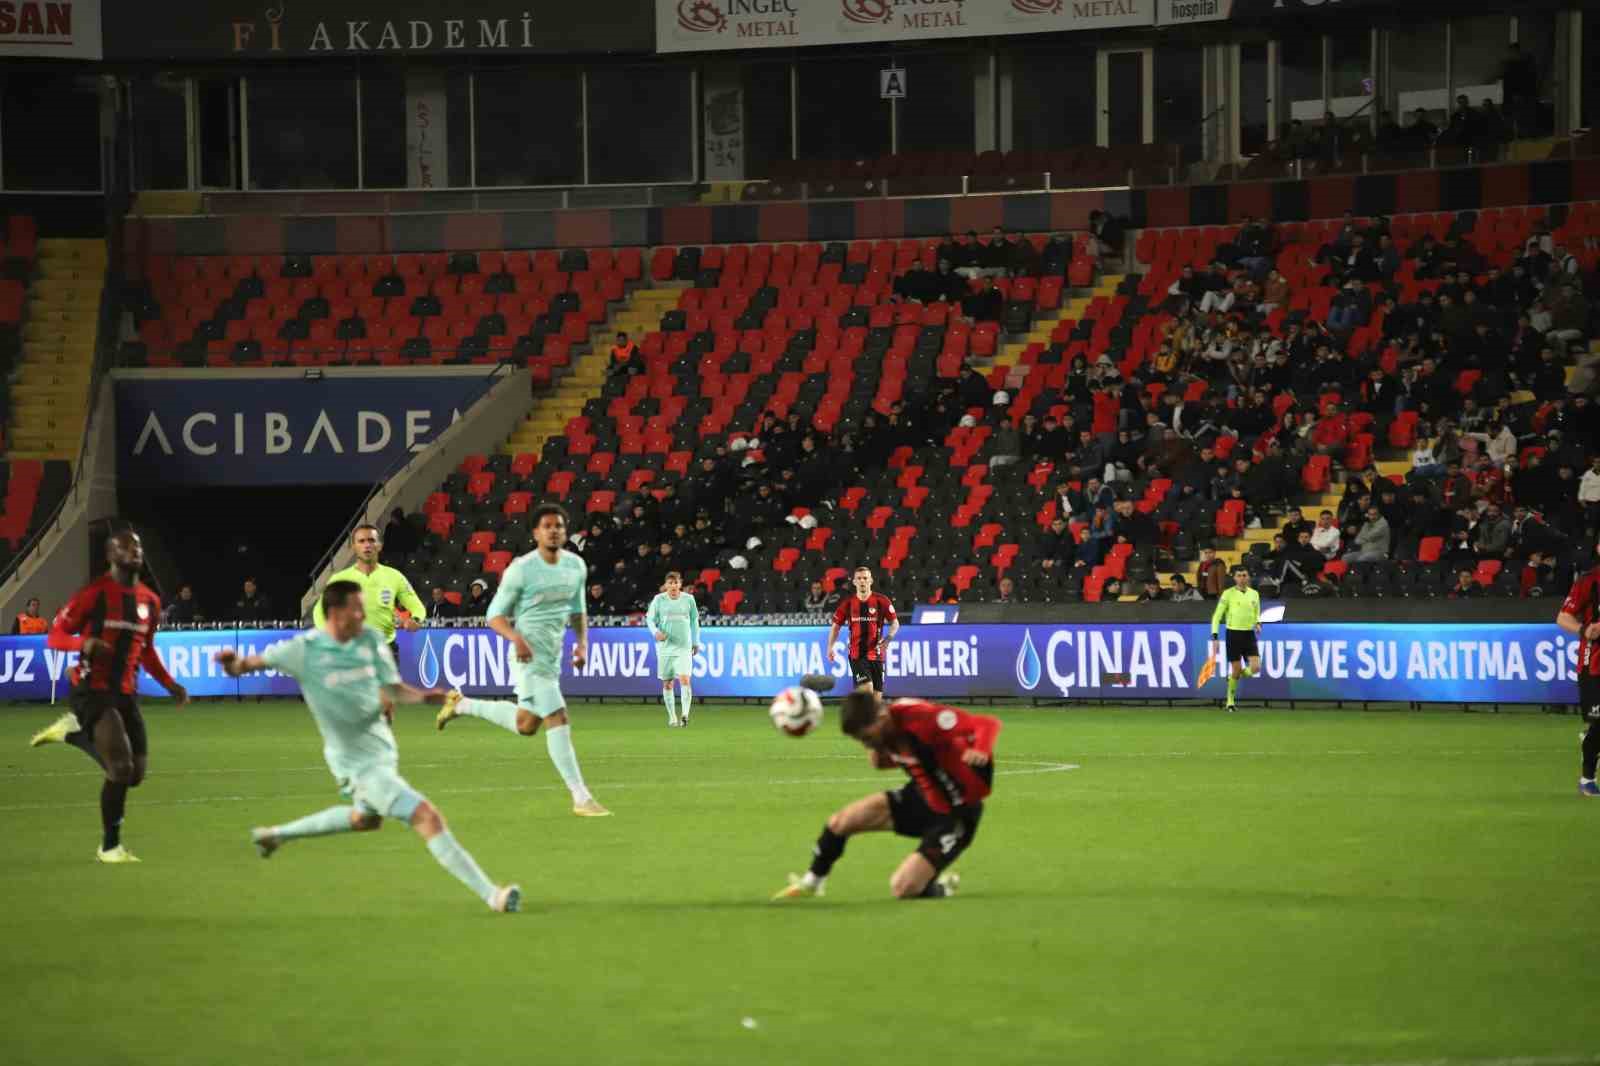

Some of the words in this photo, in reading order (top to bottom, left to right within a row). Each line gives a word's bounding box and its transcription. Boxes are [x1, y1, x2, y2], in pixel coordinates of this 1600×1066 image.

[904, 11, 968, 28] METAL
[1073, 0, 1138, 18] METAL
[1171, 0, 1218, 19] hospital
[308, 11, 536, 50] AKADEMİ
[736, 20, 799, 37] METAL
[886, 72, 902, 94] A
[132, 408, 461, 455] ACIBADE
[692, 641, 724, 677] SU
[731, 642, 826, 677] ARITMA
[1046, 630, 1189, 697] ÇINAR
[1310, 640, 1349, 679] VE
[1357, 640, 1398, 680] SU
[1407, 641, 1528, 681] ARITMA
